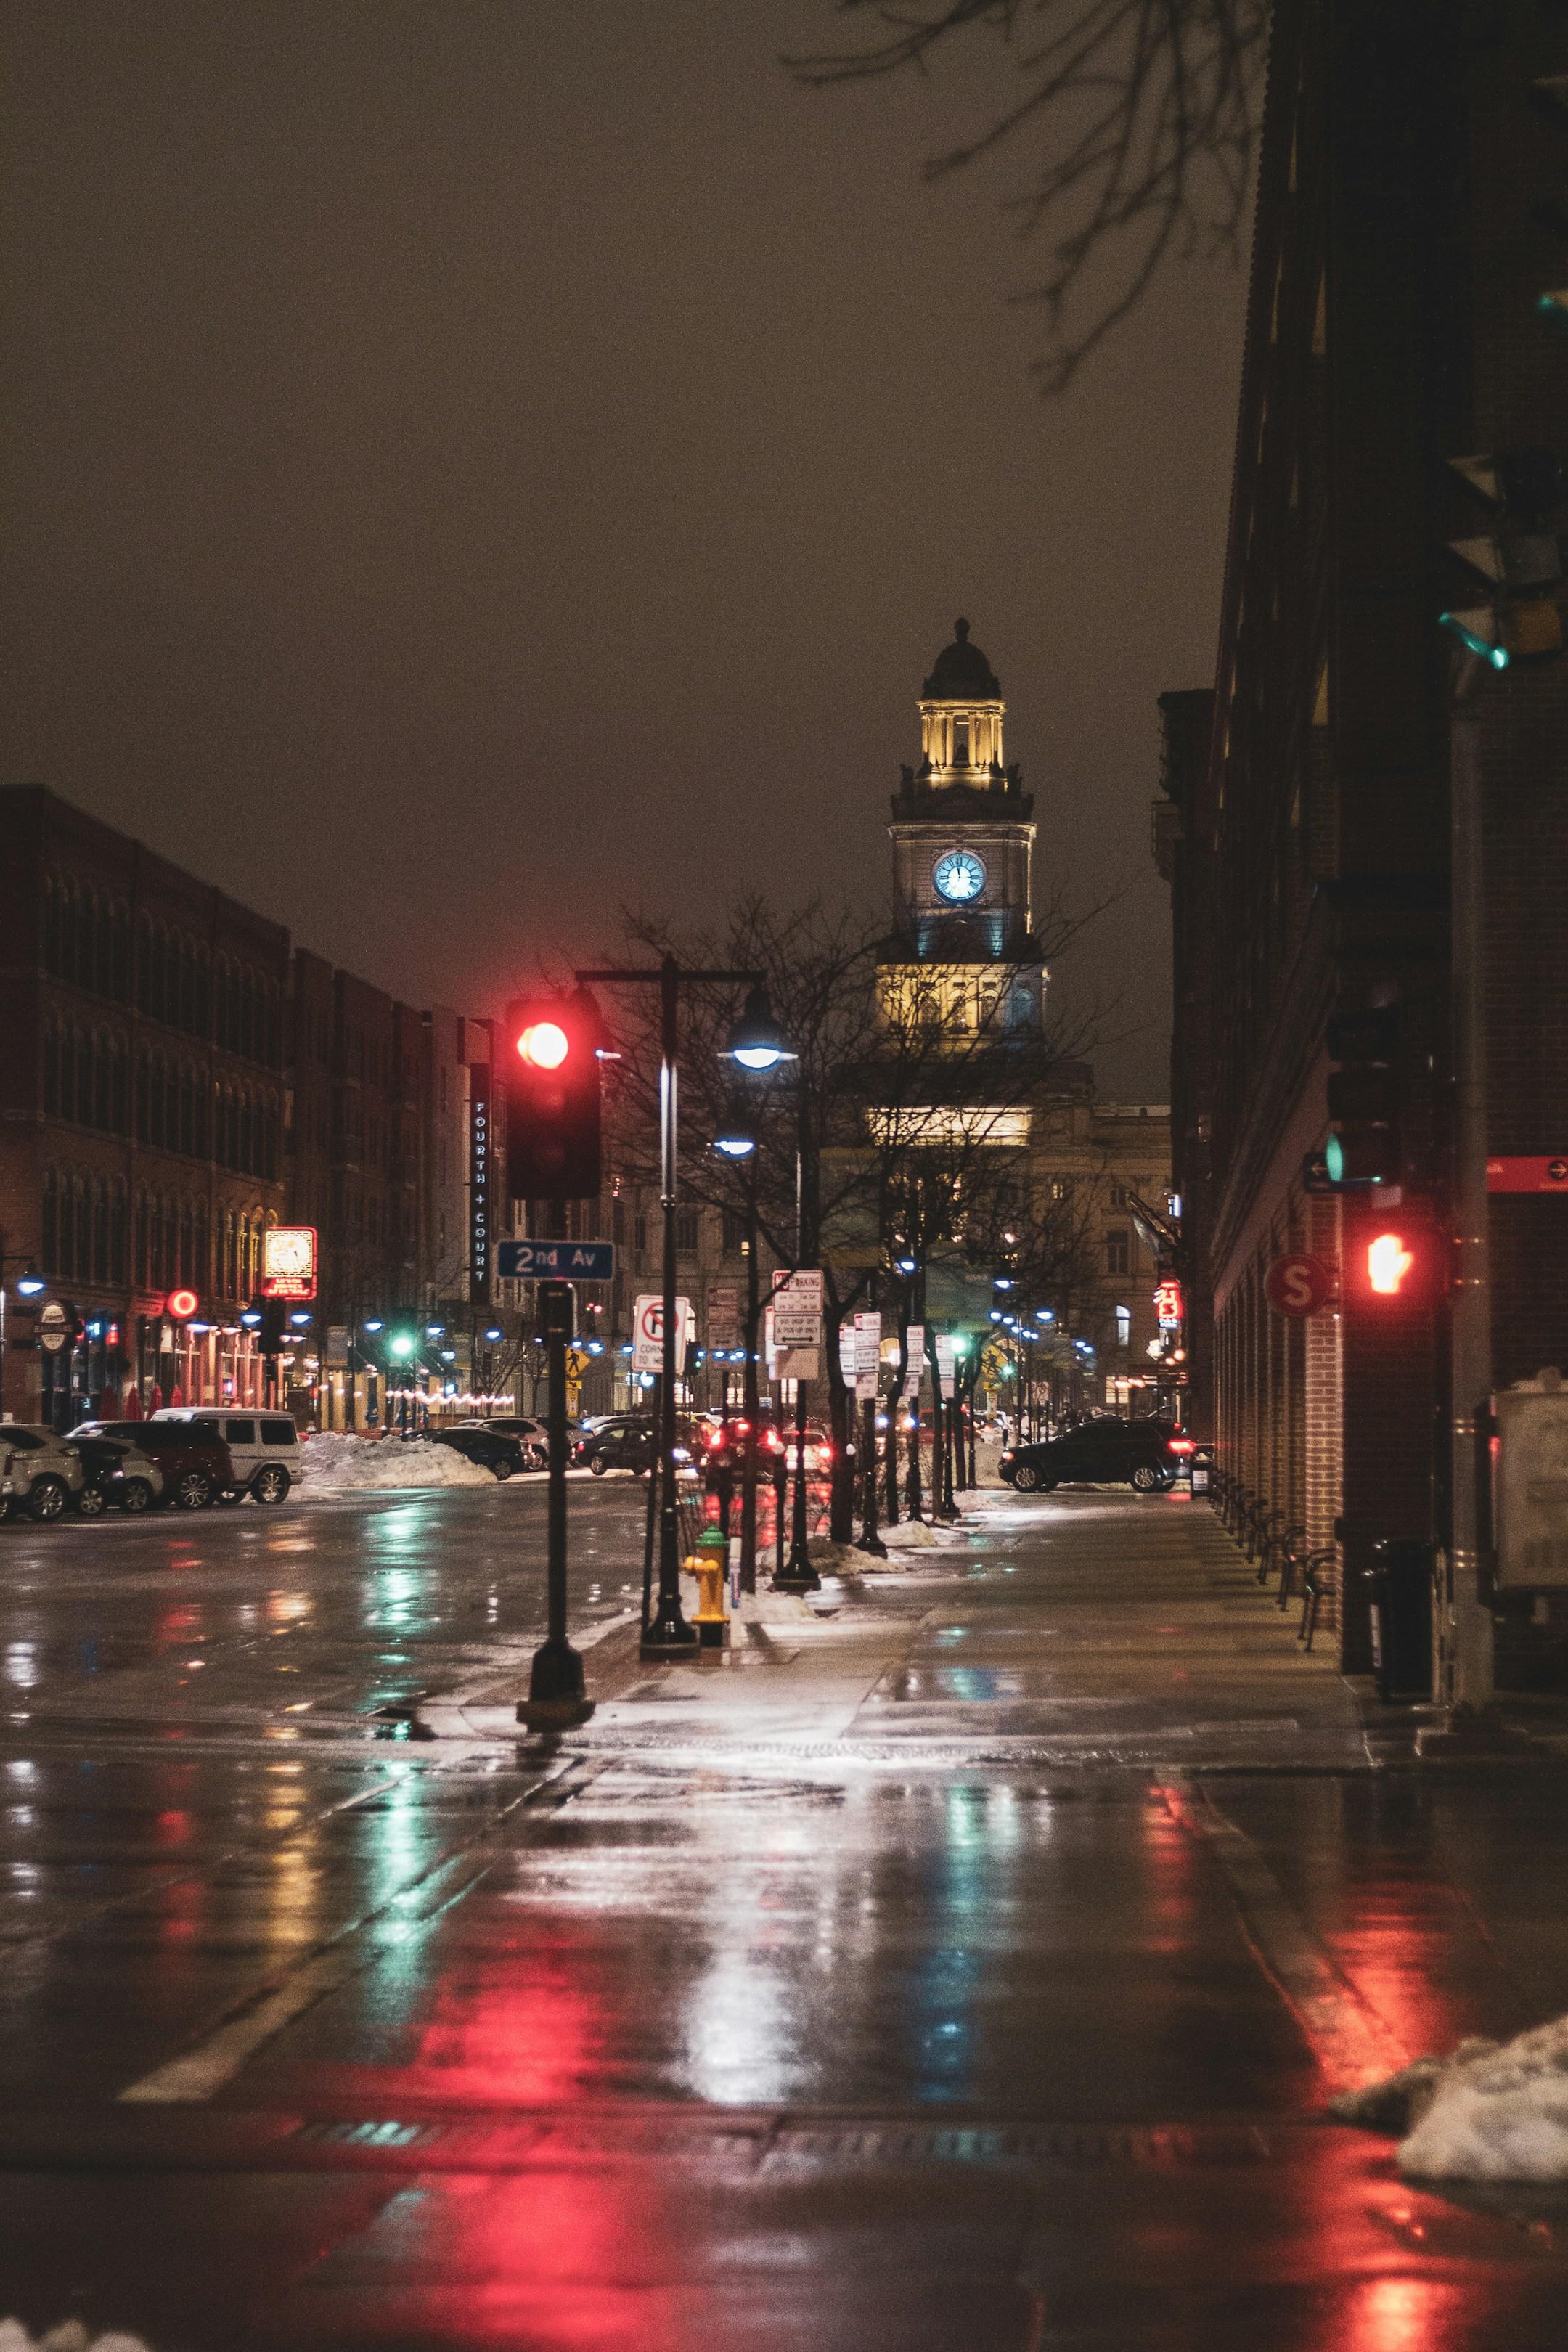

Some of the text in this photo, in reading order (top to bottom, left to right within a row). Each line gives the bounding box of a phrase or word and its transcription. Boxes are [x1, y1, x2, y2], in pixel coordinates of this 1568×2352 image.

[475, 1101, 486, 1282] FOURTH + COURT
[515, 1246, 595, 1273] 2nd Av
[790, 1277, 819, 1288] PARKING
[1283, 1265, 1312, 1306] S
[640, 1344, 663, 1354] CORN
